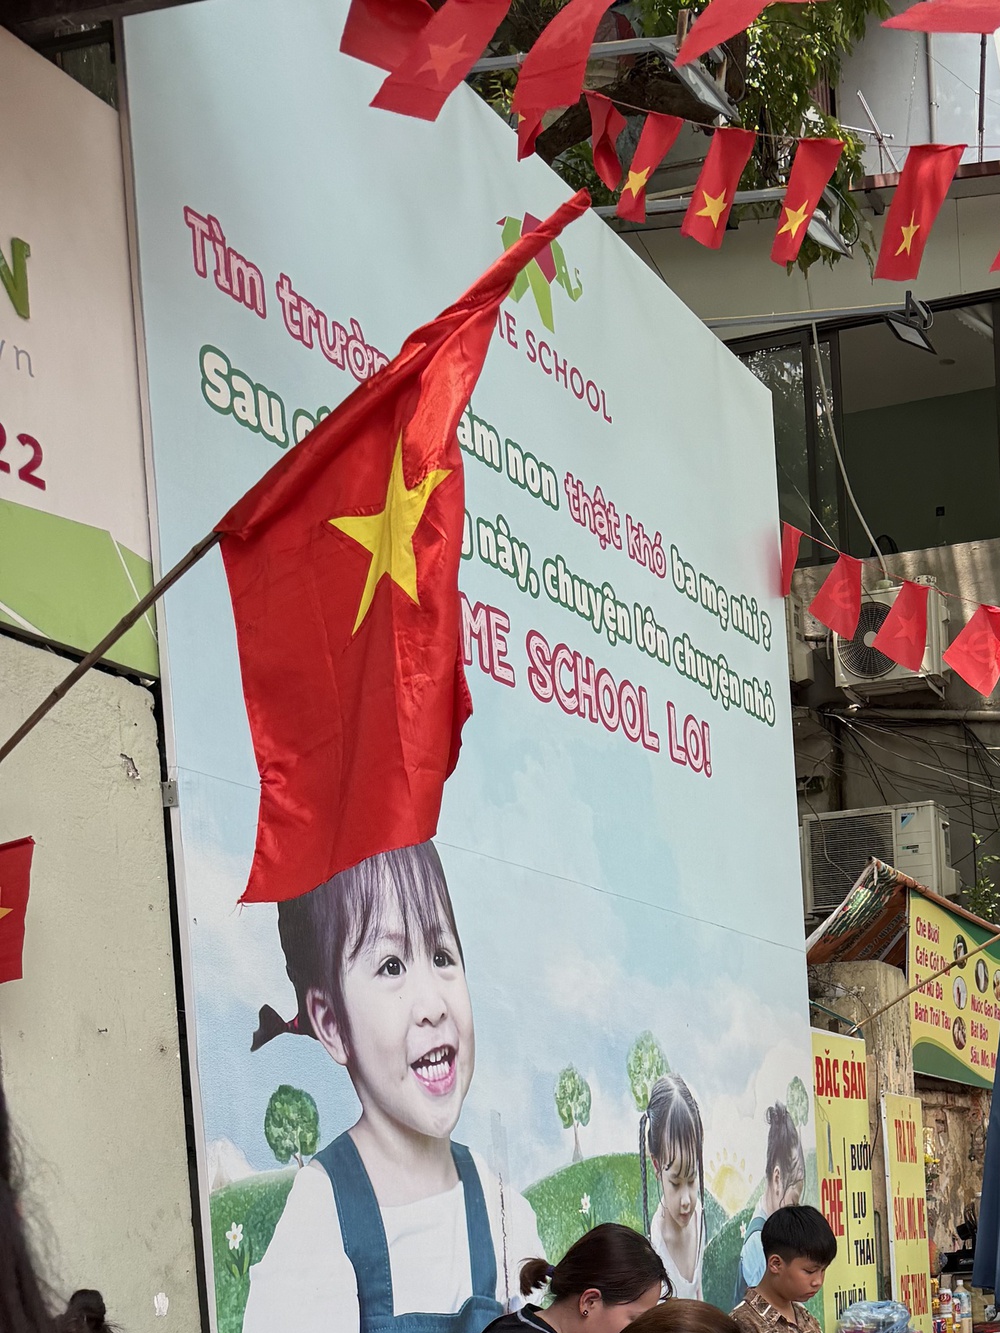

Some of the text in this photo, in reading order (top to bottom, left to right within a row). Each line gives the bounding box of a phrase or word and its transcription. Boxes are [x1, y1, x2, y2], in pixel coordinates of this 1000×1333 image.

[183, 205, 267, 319] Tìm
[525, 329, 612, 424] SCHOOL
[199, 344, 289, 449] Sau
[505, 438, 560, 512] non
[564, 471, 622, 551] thật
[626, 513, 666, 579] khó
[671, 543, 698, 603] ba
[700, 572, 729, 631] mẹ
[477, 513, 540, 598] này,
[543, 554, 632, 646] chuyện
[673, 632, 741, 711] chuyện
[743, 677, 776, 727] nhỏ
[526, 630, 660, 752] SCHOOL
[666, 701, 713, 777] LO!
[815, 1048, 867, 1105] ĐẶC SẢN
[894, 1104, 917, 1164] TRÀ TẮC
[821, 1135, 872, 1237] CHÈ BƯỞI
[852, 1192, 867, 1224] LỊU
[854, 1235, 875, 1266] THÁI
